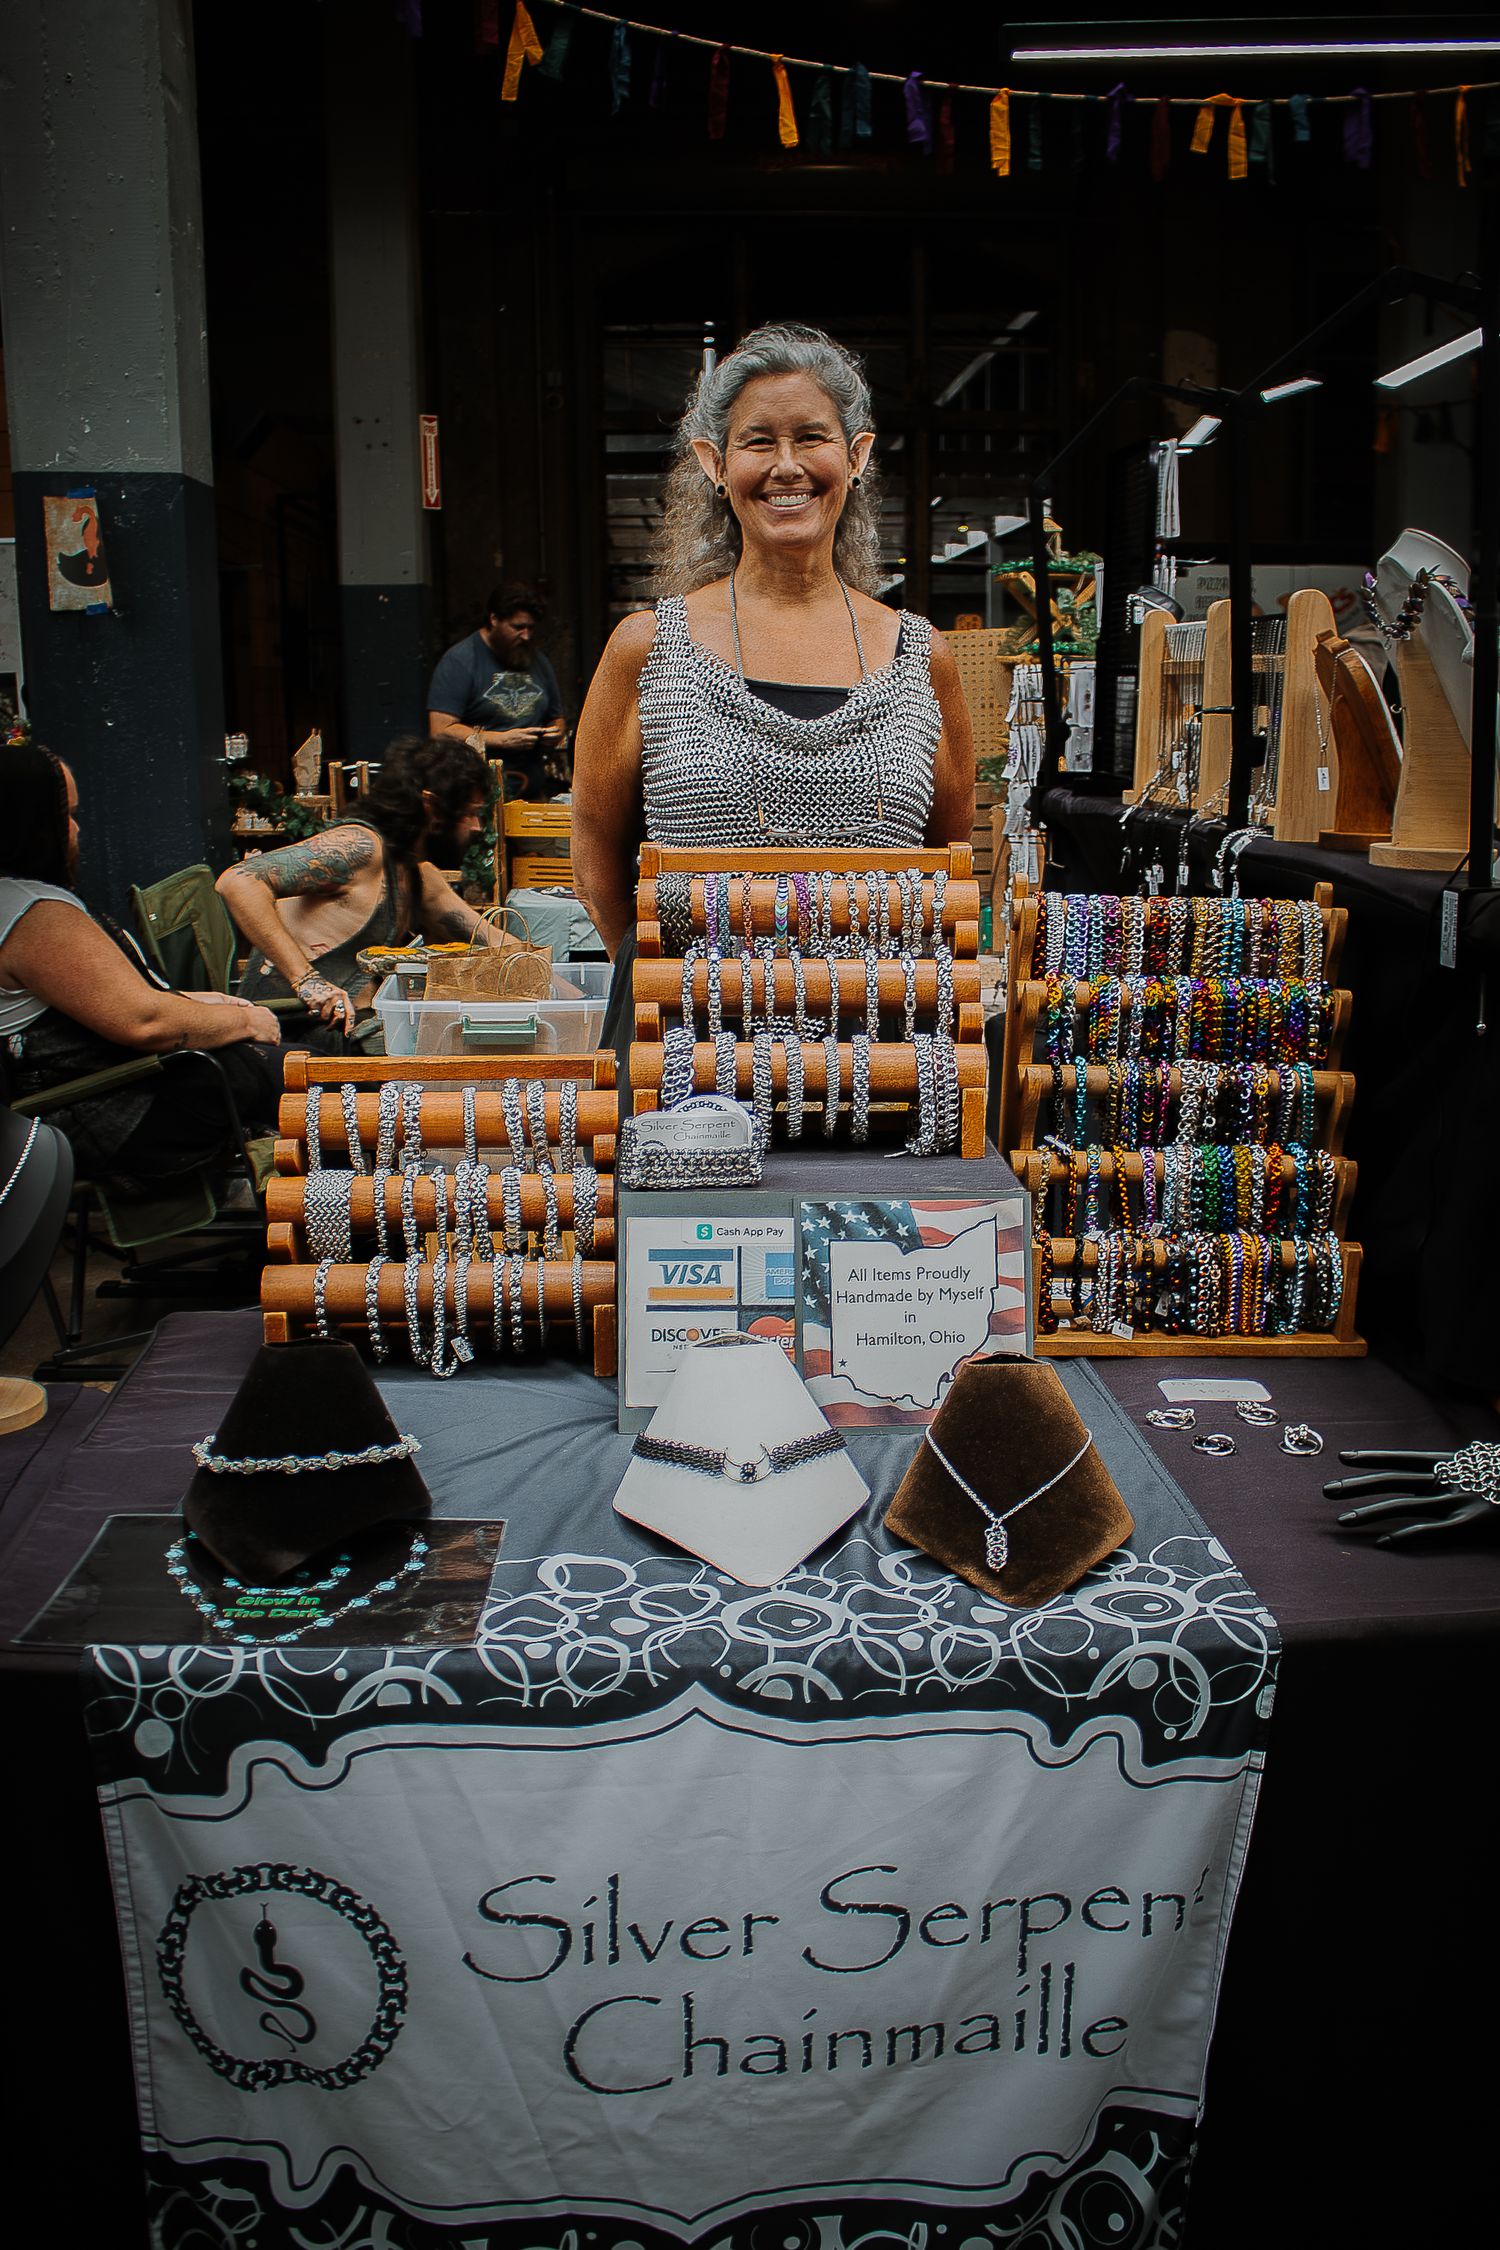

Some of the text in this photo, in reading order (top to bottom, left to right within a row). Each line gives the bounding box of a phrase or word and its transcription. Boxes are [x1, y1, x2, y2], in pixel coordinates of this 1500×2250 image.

[639, 1119, 736, 1133] Silver Serpent
[673, 1131, 731, 1142] Chainmaille
[716, 1227, 784, 1238] Cash App Pay
[659, 1264, 722, 1285] VISA
[848, 1265, 971, 1283] All Items Proudly
[836, 1286, 985, 1305] Handmade by Myself
[904, 1311, 917, 1323] in
[651, 1328, 722, 1342] DISCOVE
[856, 1330, 966, 1346] Hamilton, Ohio
[236, 1596, 296, 1606] Glow
[222, 1607, 325, 1618] The Dark
[461, 1872, 780, 1983] Silver
[563, 1961, 1129, 2095] Chainmaille
